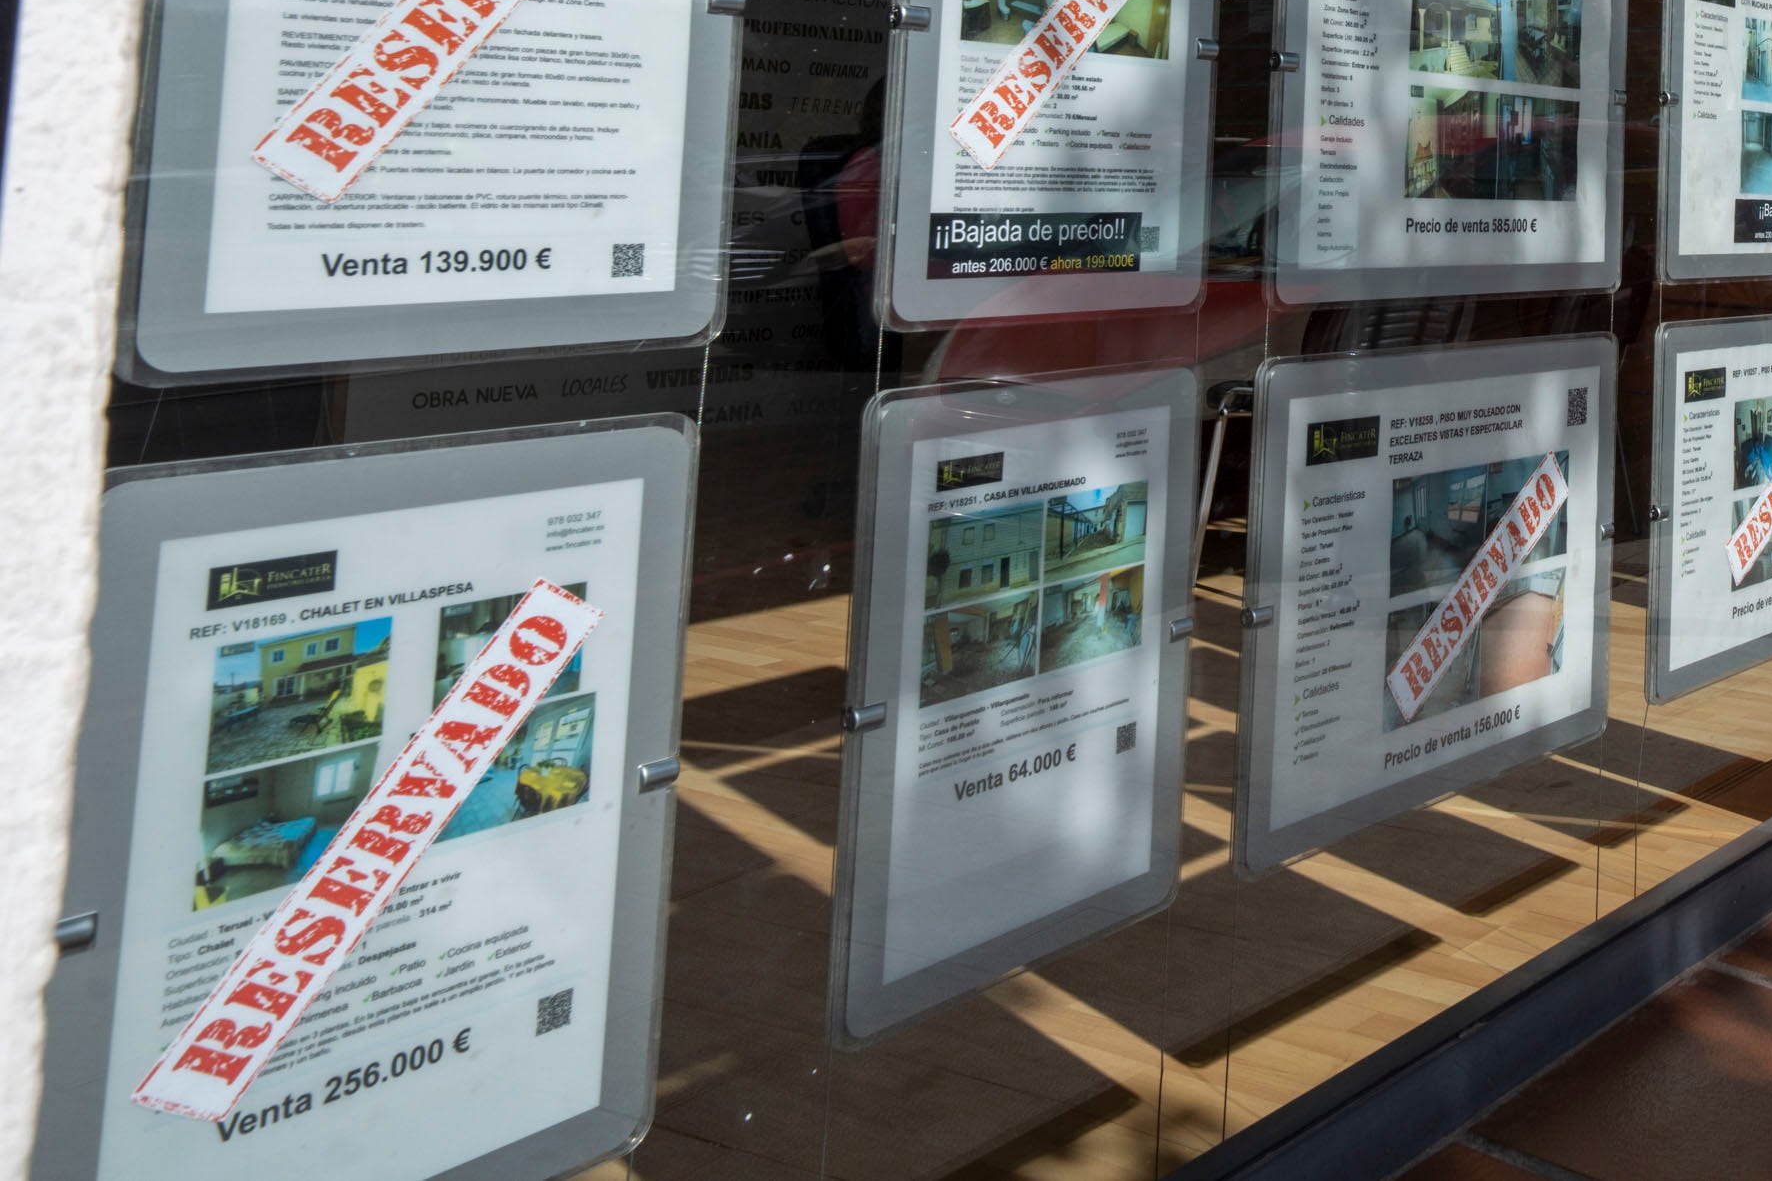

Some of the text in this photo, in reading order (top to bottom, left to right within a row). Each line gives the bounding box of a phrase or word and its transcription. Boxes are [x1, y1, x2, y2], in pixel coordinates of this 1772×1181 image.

[809, 62, 869, 79] CONFIANZA
[1329, 115, 1364, 127] Calidades
[935, 219, 1125, 249] ¡¡Bajada de precio!!
[1406, 218, 1537, 233] Precio de venta 585.000 €
[322, 248, 552, 277] Venta 139.900 €
[952, 254, 1134, 274] antes 206.000 € ahora 199.000€
[412, 389, 469, 410] OBRA
[476, 384, 537, 405] NUEVA
[561, 374, 628, 397] LOCALES
[1390, 420, 1523, 447] EXCELENTES VISTAS Y ESPECTACULAR
[1389, 451, 1423, 465] TERRAZA
[928, 477, 1086, 512] REF: V18251 CASA EN VILLARQUEMADO
[1312, 490, 1366, 508] Características
[267, 563, 331, 584] FINCATER
[1400, 473, 1556, 702] RESERVADO
[189, 582, 473, 640] REF: V18169 CHALET EN VILLASPESA
[1301, 679, 1340, 701] Calidades
[1384, 705, 1520, 769] Precio de venta 156.000 €
[954, 743, 1077, 801] Venta 64.000 €
[172, 615, 567, 1085] RESERVADO
[334, 925, 529, 996] incluido Patio Cocina equipada
[358, 940, 418, 966] Despejadas
[372, 941, 532, 1000] Barbacoa Jardín Exterior
[217, 1028, 471, 1143] Venta 256.000 €
